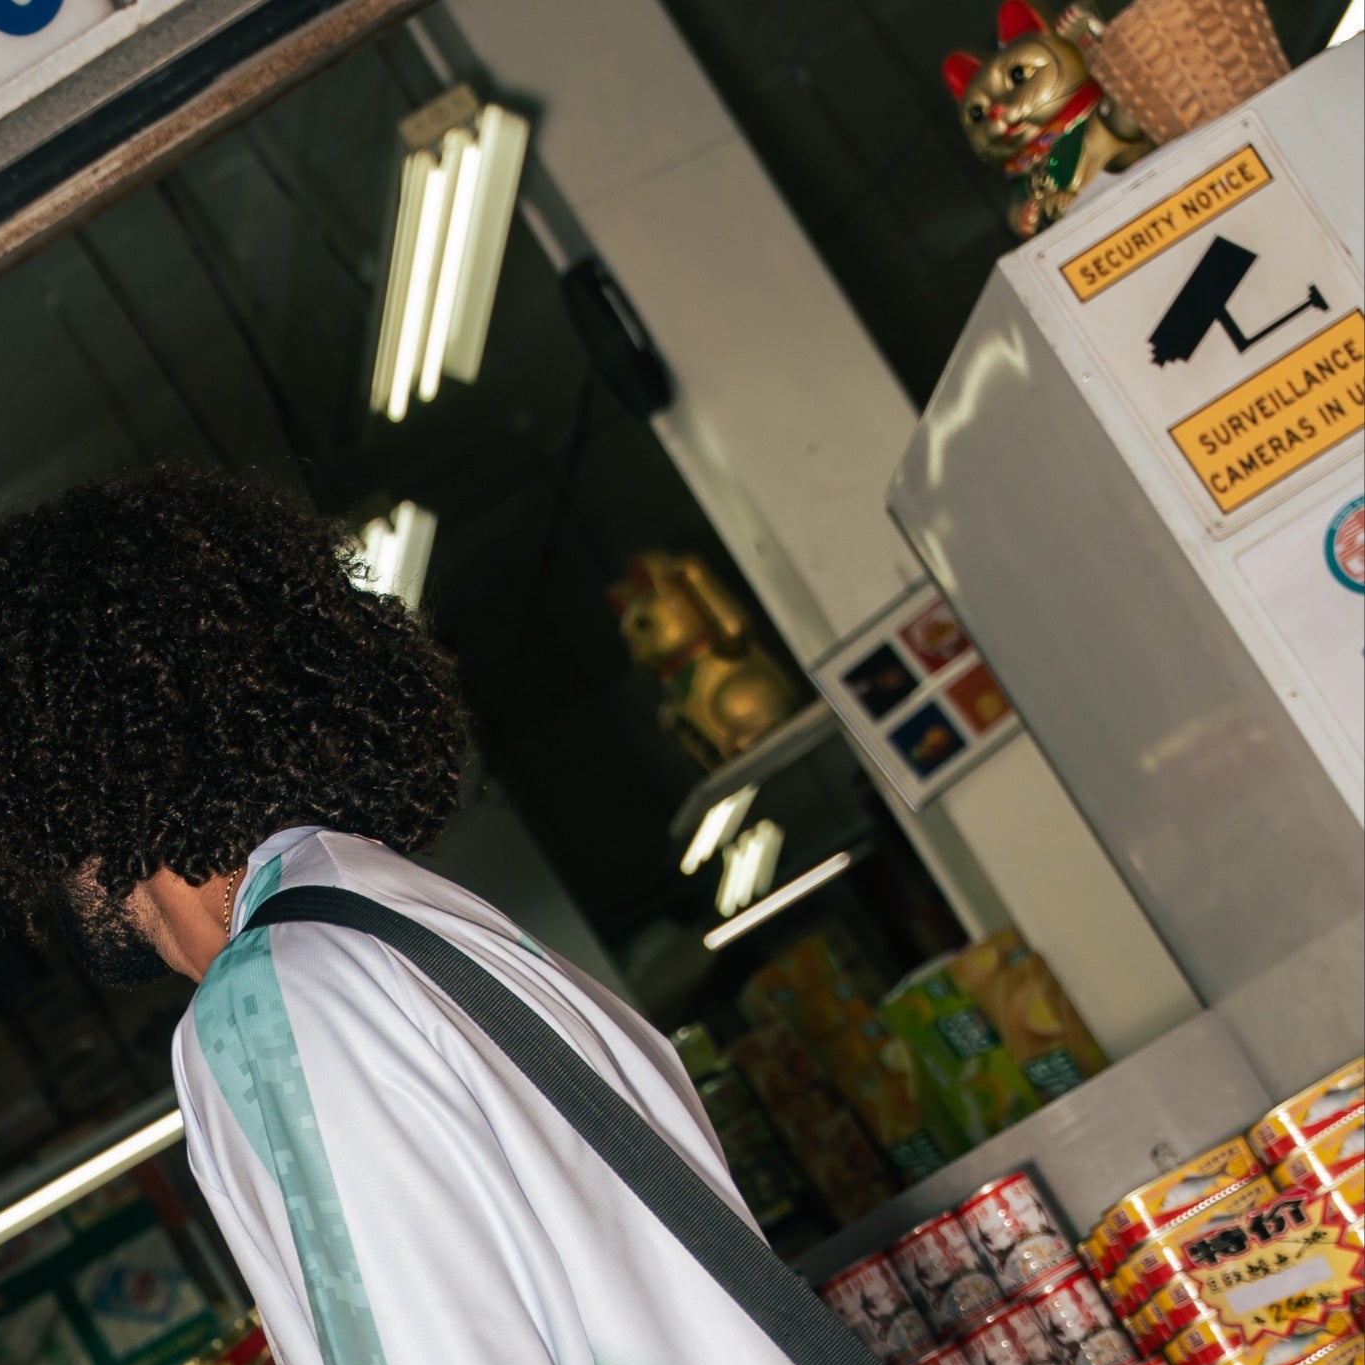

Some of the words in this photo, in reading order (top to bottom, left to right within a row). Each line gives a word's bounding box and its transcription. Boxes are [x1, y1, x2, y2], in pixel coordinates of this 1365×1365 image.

[1079, 217, 1177, 286] SECURITY
[1181, 160, 1257, 222] NOTICE
[1197, 339, 1365, 456] SURVEILLANCE
[1210, 424, 1316, 496] CAMERAS
[1321, 401, 1348, 431] IN
